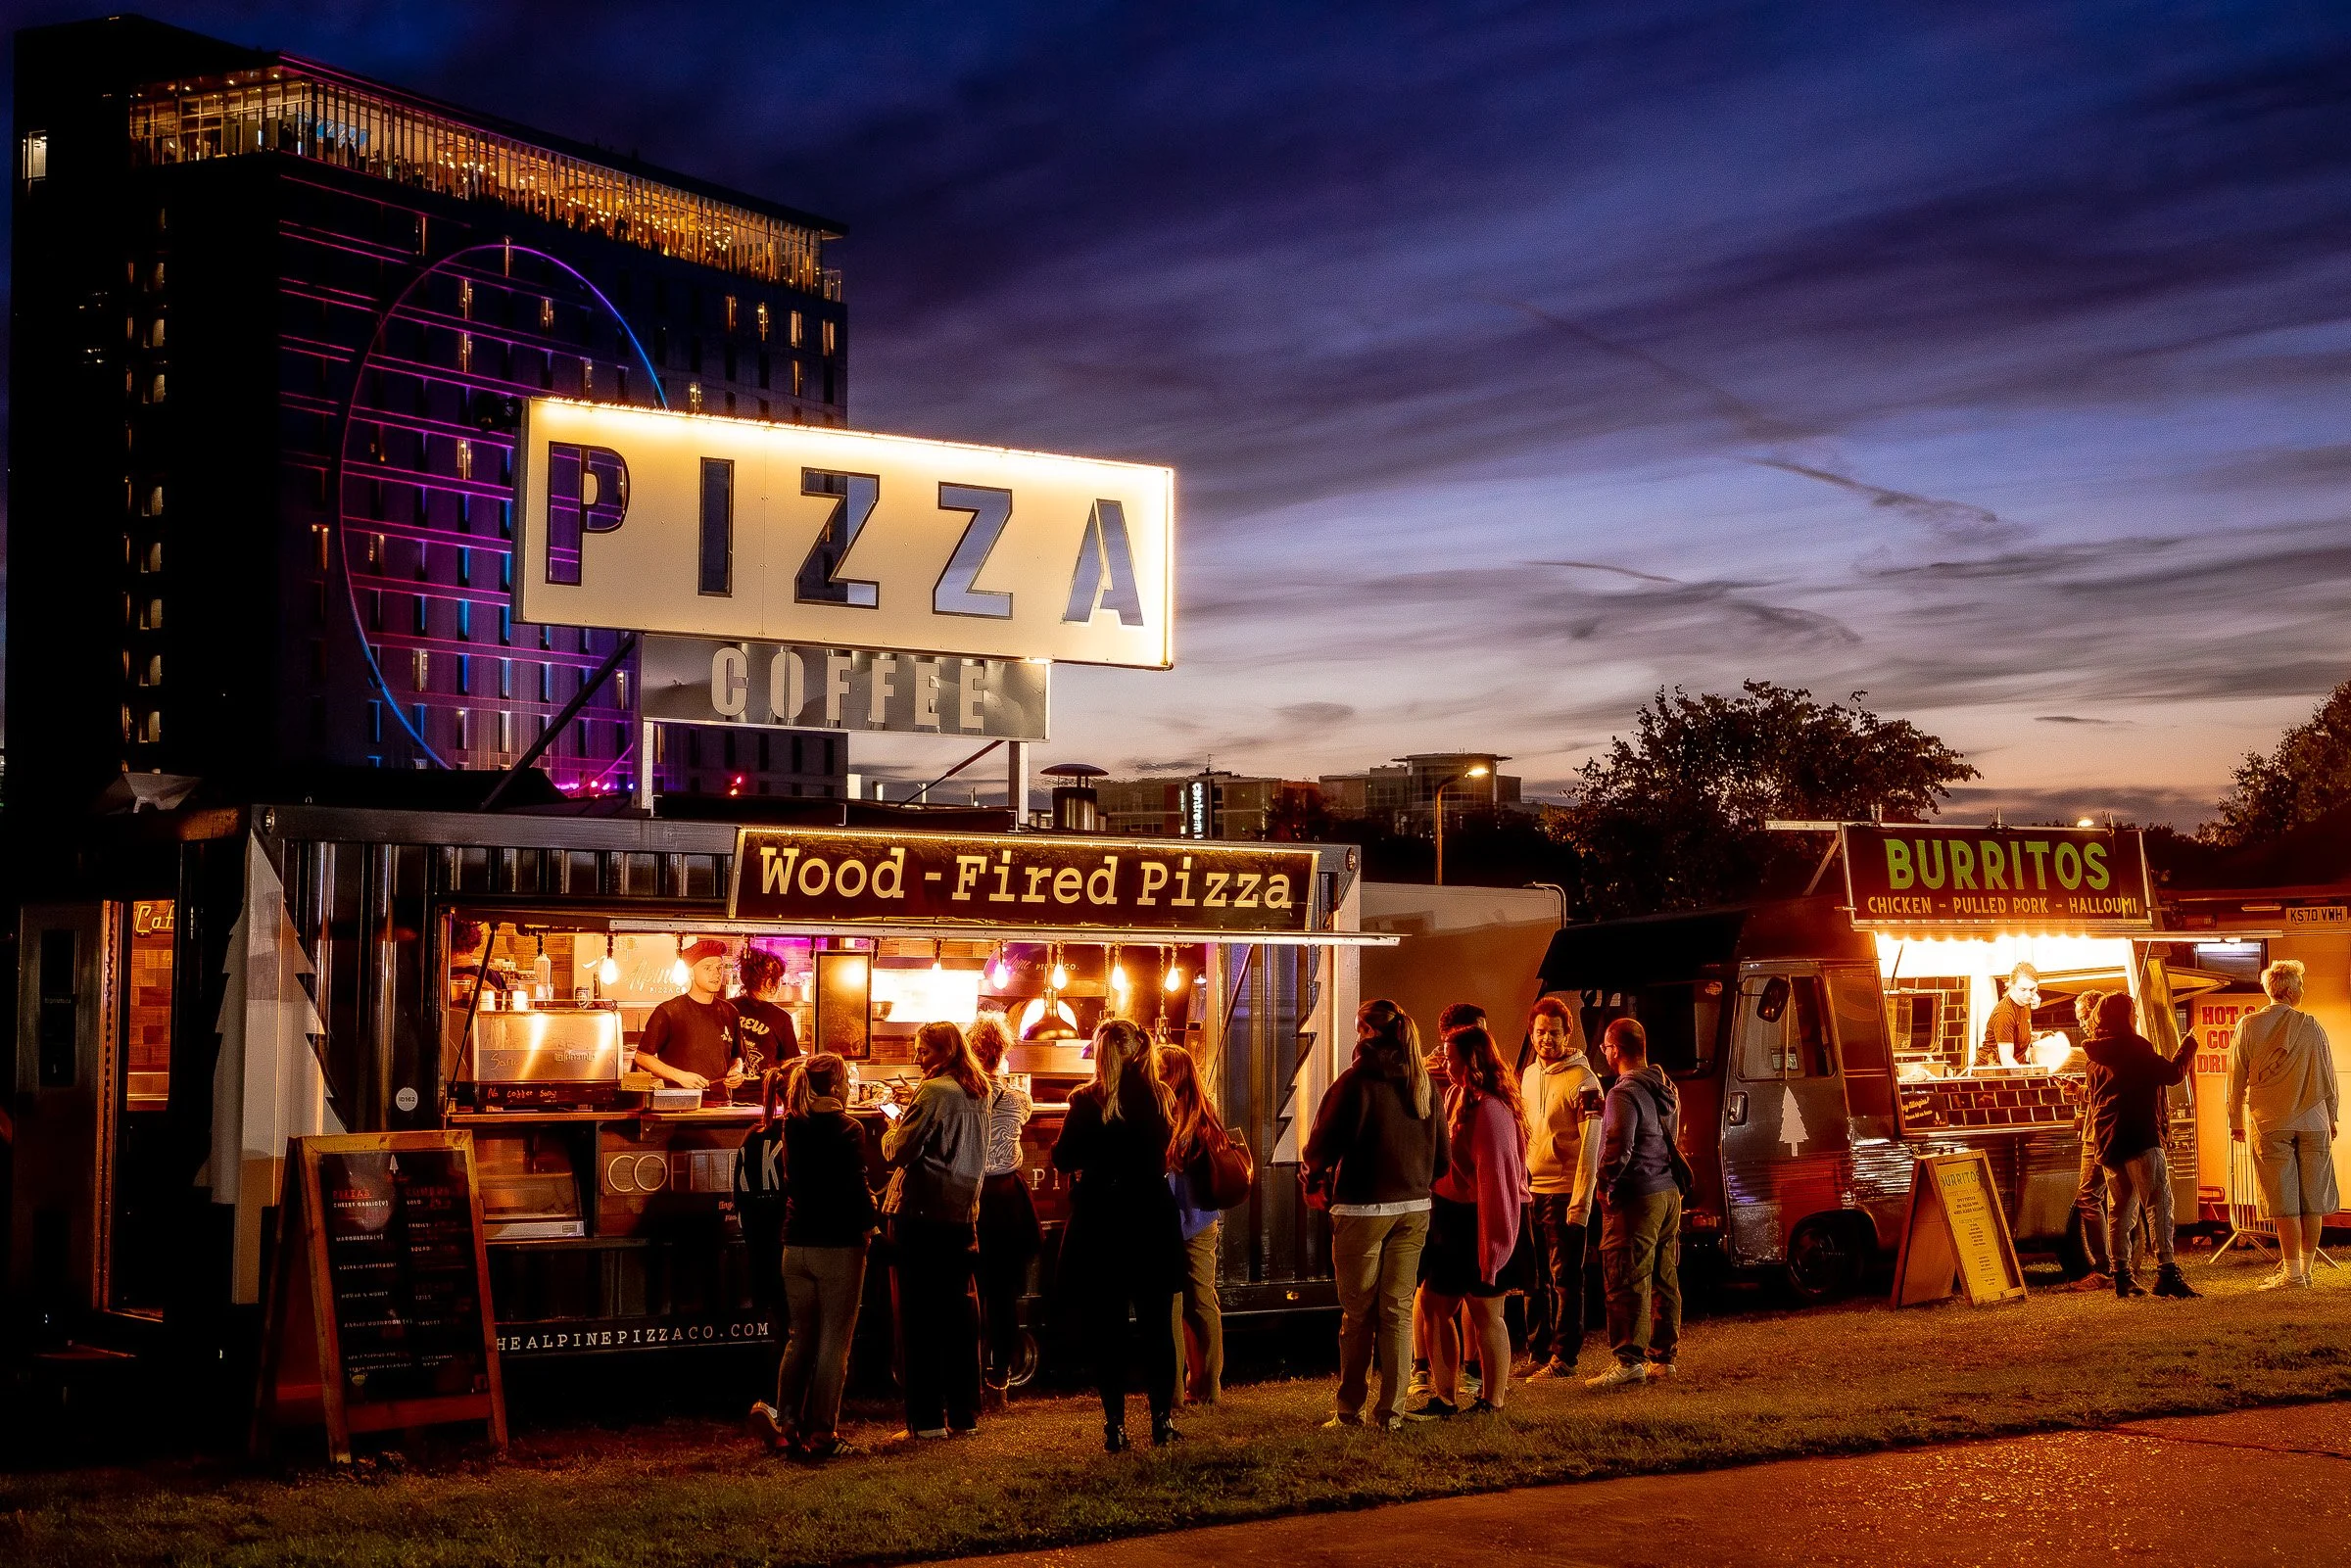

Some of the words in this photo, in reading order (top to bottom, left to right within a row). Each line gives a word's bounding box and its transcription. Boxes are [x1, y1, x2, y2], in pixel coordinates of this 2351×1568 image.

[545, 441, 1144, 626] PIZZA
[710, 647, 986, 730] COFFEE
[1885, 838, 2111, 891] BURRITOS
[760, 847, 905, 899] Wood
[1141, 855, 1292, 910] Pizza
[1868, 896, 1933, 915] CHICKEN
[1953, 896, 2007, 915] PULLED
[2012, 896, 2049, 915] PORK
[2068, 896, 2137, 915] HALLOUMI
[2290, 909, 2318, 922] KS70
[2201, 1006, 2239, 1024] HOT
[740, 1016, 770, 1035] REW
[2206, 1029, 2235, 1049] CO
[2196, 1054, 2228, 1073] DRI
[496, 1320, 770, 1352] HEALPINEPIZZACO.COM
